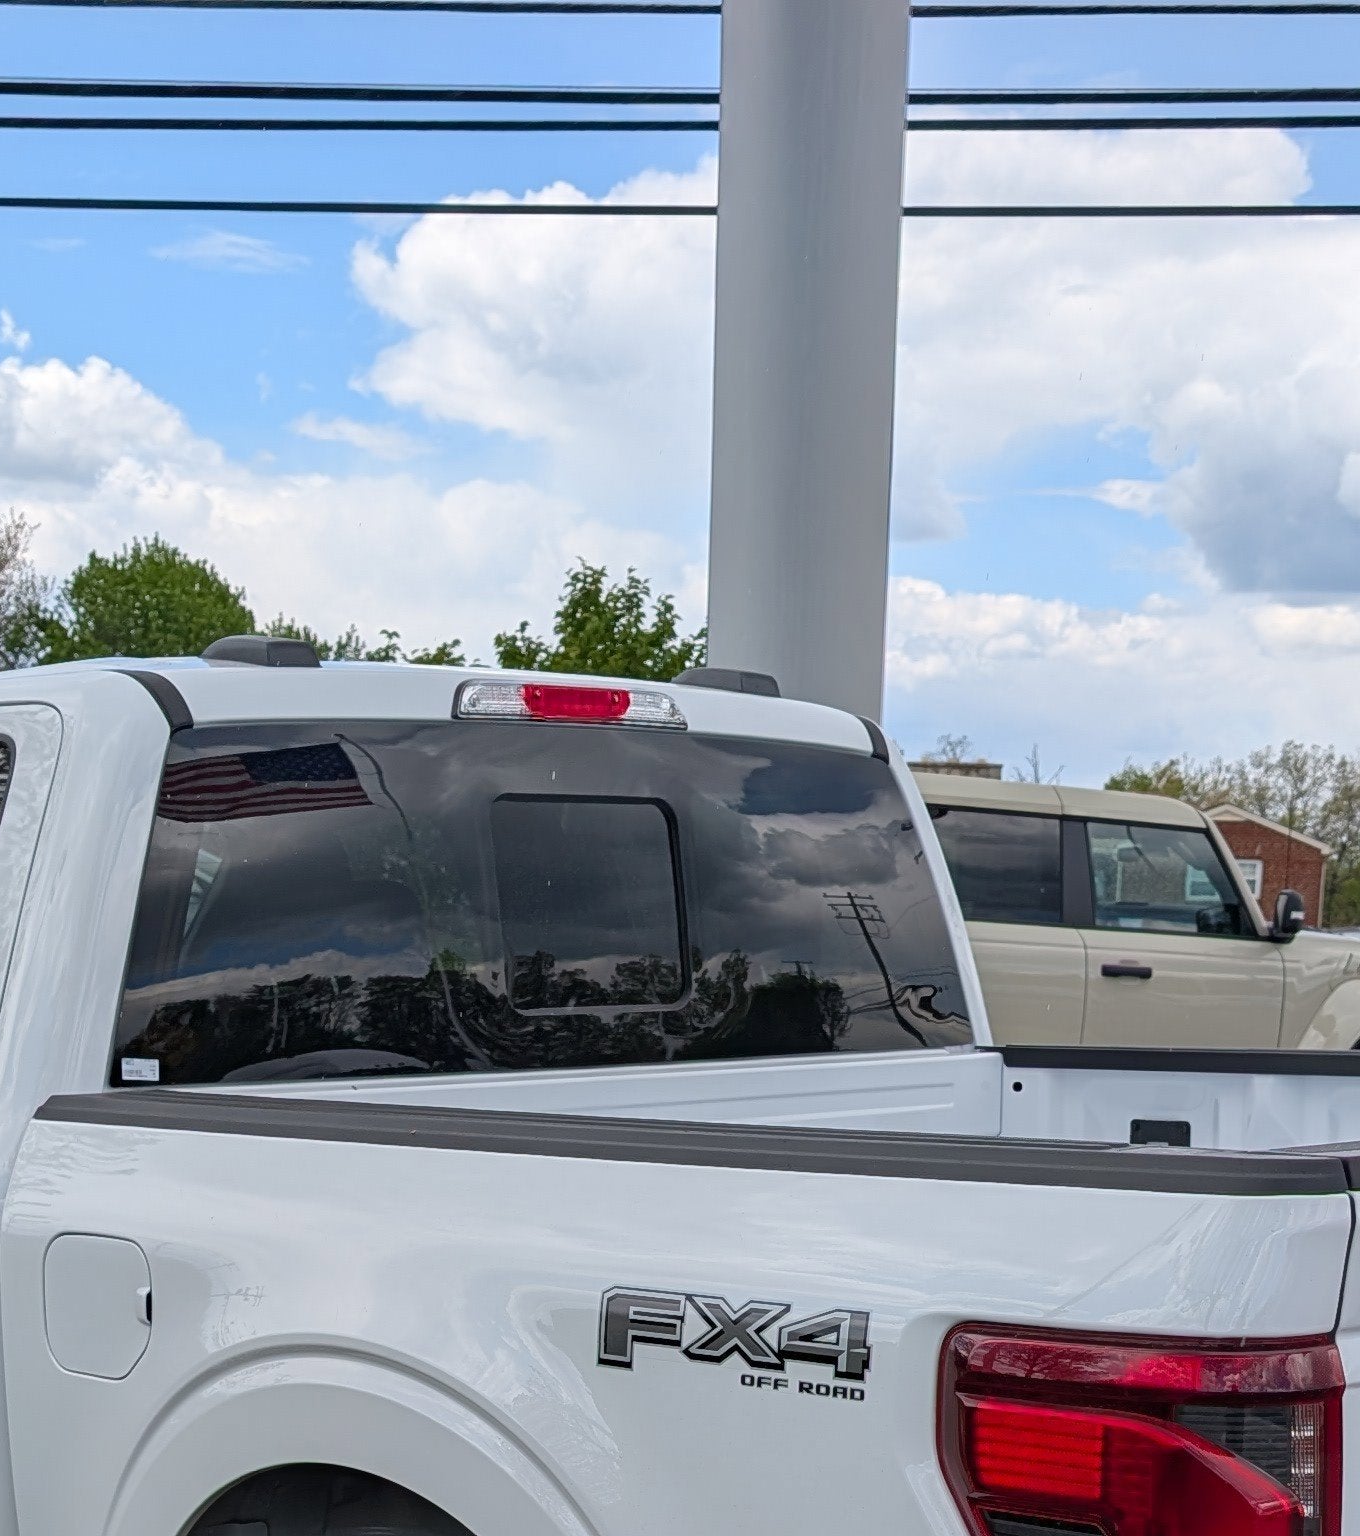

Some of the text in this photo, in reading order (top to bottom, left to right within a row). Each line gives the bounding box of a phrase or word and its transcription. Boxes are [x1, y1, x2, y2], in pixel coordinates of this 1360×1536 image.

[596, 1285, 873, 1383] FX4
[740, 1374, 865, 1402] OFF ROAD
